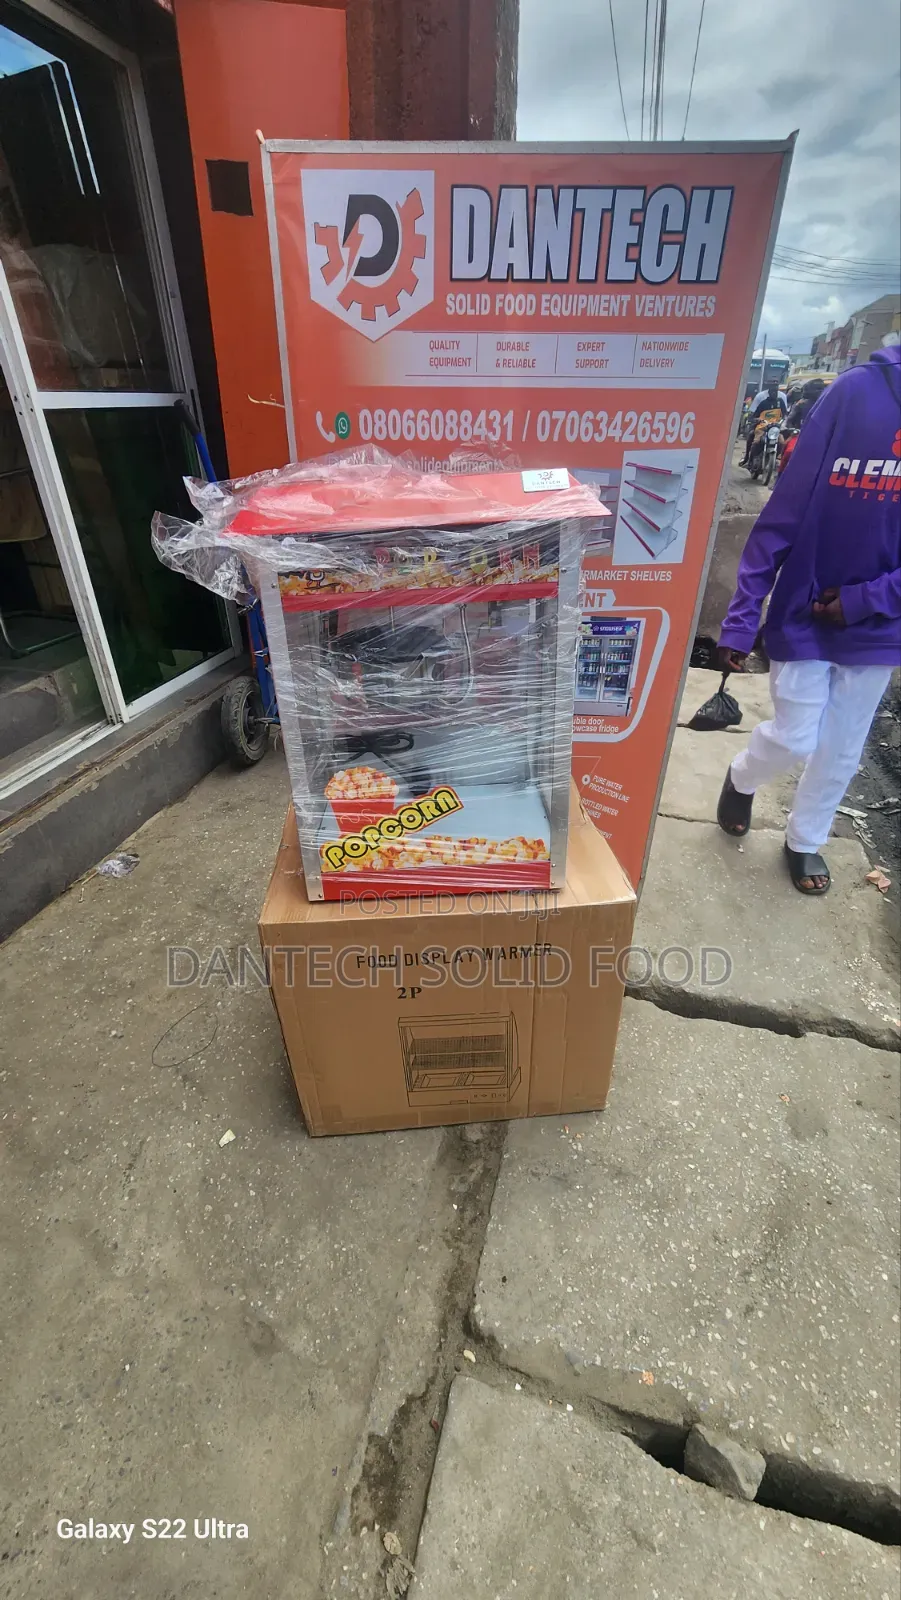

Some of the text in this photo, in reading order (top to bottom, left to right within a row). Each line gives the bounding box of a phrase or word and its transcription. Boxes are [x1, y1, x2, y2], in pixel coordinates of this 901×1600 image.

[450, 184, 734, 286] DANTECH
[446, 293, 716, 318] SOLID FOOD EQUIPMENT VENTURES
[429, 340, 461, 352] QUALITY
[496, 341, 530, 352] DURABLE
[577, 341, 606, 352] EXPERT
[641, 341, 689, 352] NATIONWIDE
[429, 357, 472, 369] EQUIPMENT
[495, 358, 536, 369] & RELIABLE
[575, 358, 609, 369] SUPPORT
[639, 358, 675, 368] DELIVERY
[358, 408, 696, 443] 08066088431 / 07063426596
[828, 457, 901, 491] CLEM
[849, 490, 901, 503] TIGE
[581, 570, 672, 581] RMARKET SHELVES
[573, 716, 604, 725] uble door
[599, 725, 619, 734] fridge
[605, 780, 623, 791] WATER
[588, 782, 630, 803] PRODUCTION LINE
[602, 804, 619, 816] WATER
[325, 789, 459, 869] POPCORN
[356, 942, 552, 968] FOOD DISPLAY WARMER
